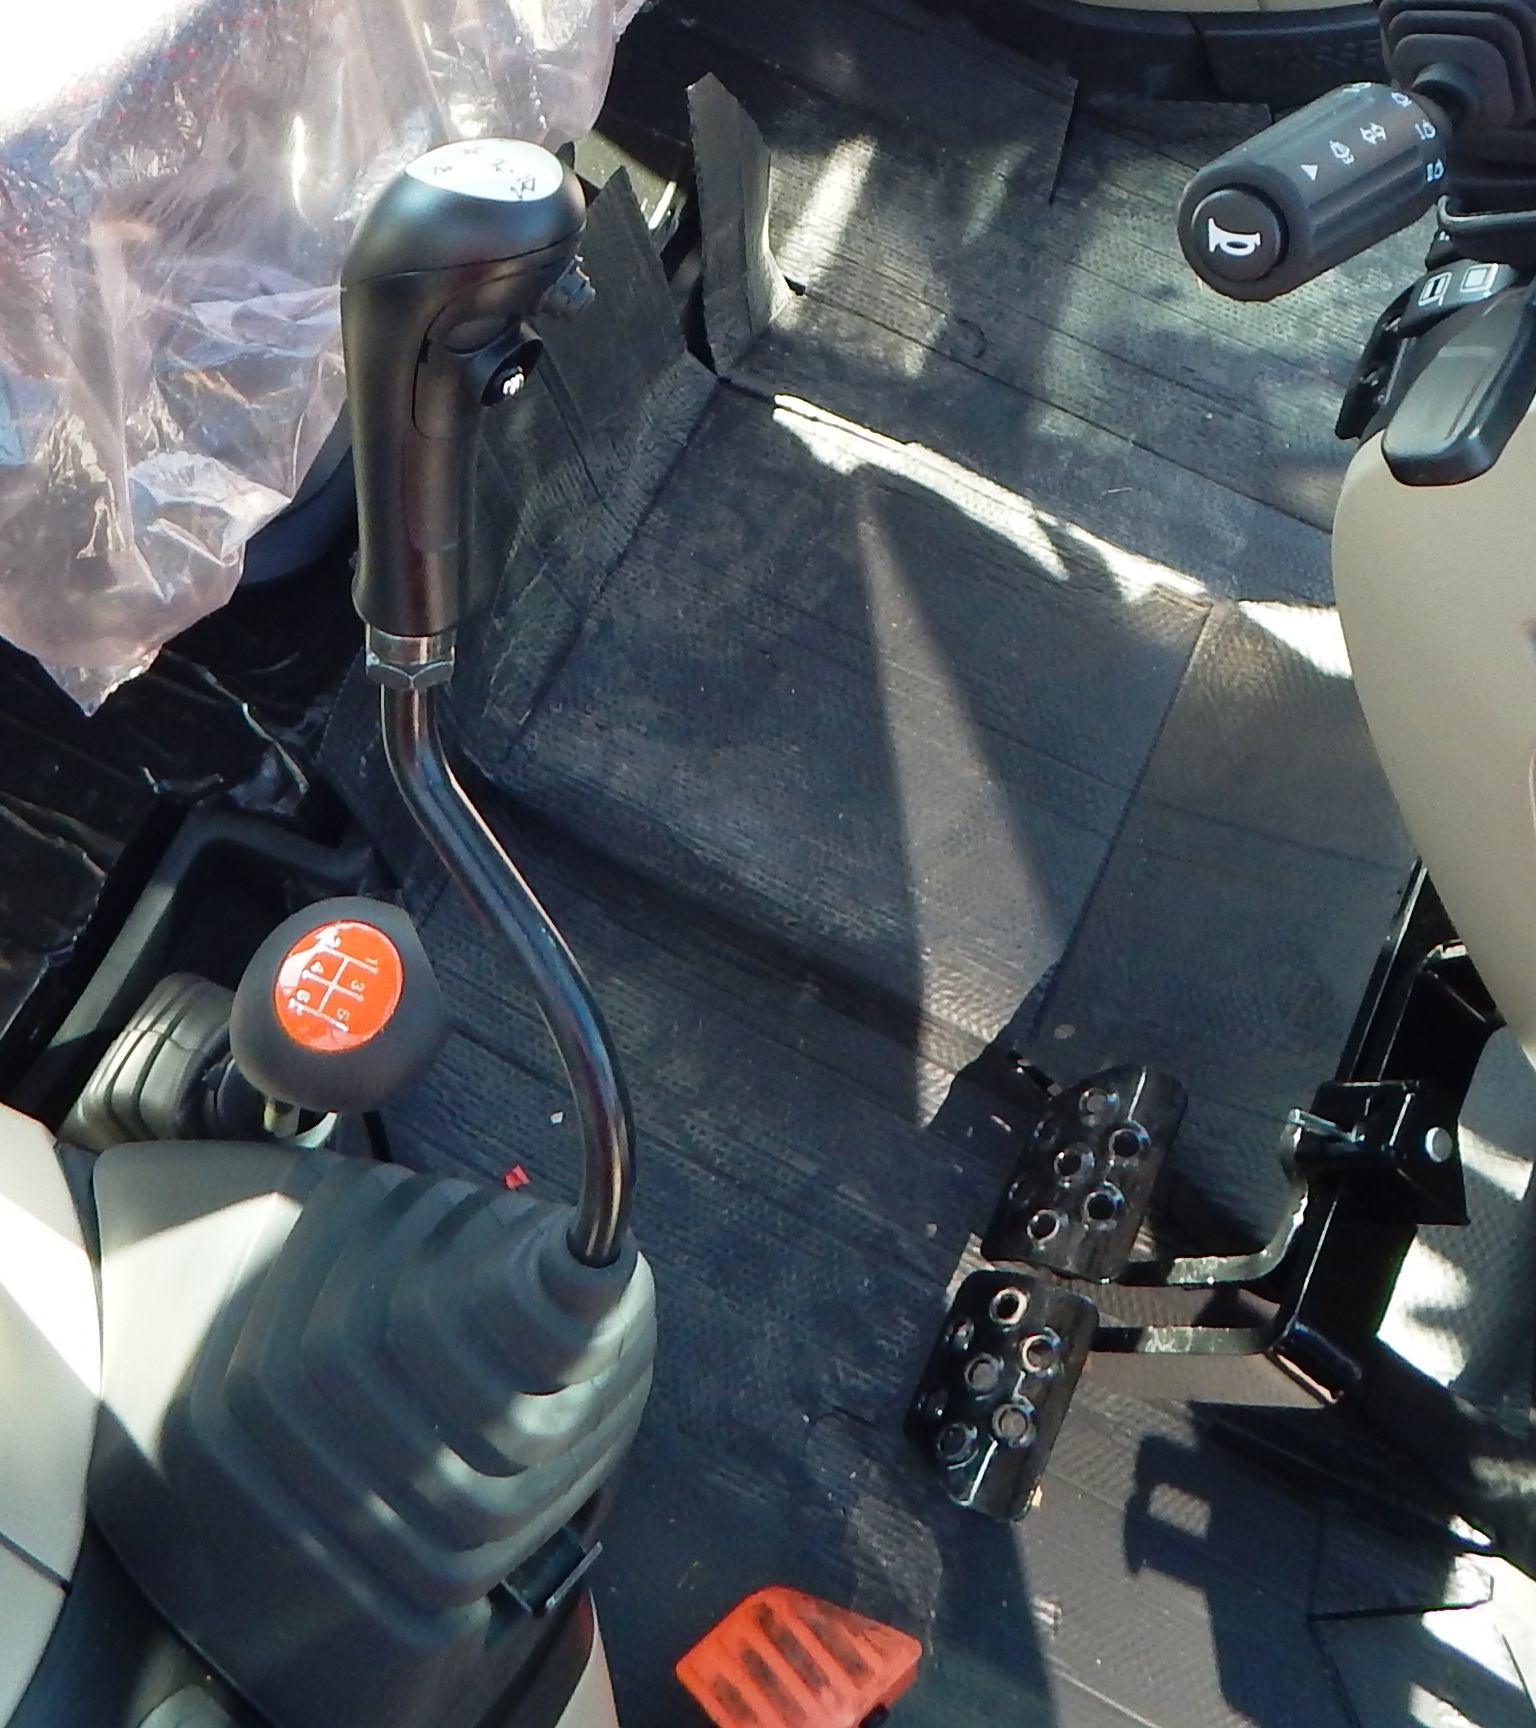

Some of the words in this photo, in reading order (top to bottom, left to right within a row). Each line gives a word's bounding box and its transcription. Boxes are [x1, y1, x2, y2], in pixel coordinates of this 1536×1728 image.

[310, 960, 325, 975] 4
[351, 980, 365, 992] 3
[296, 989, 311, 1003] 6
[337, 1008, 350, 1021] 5
